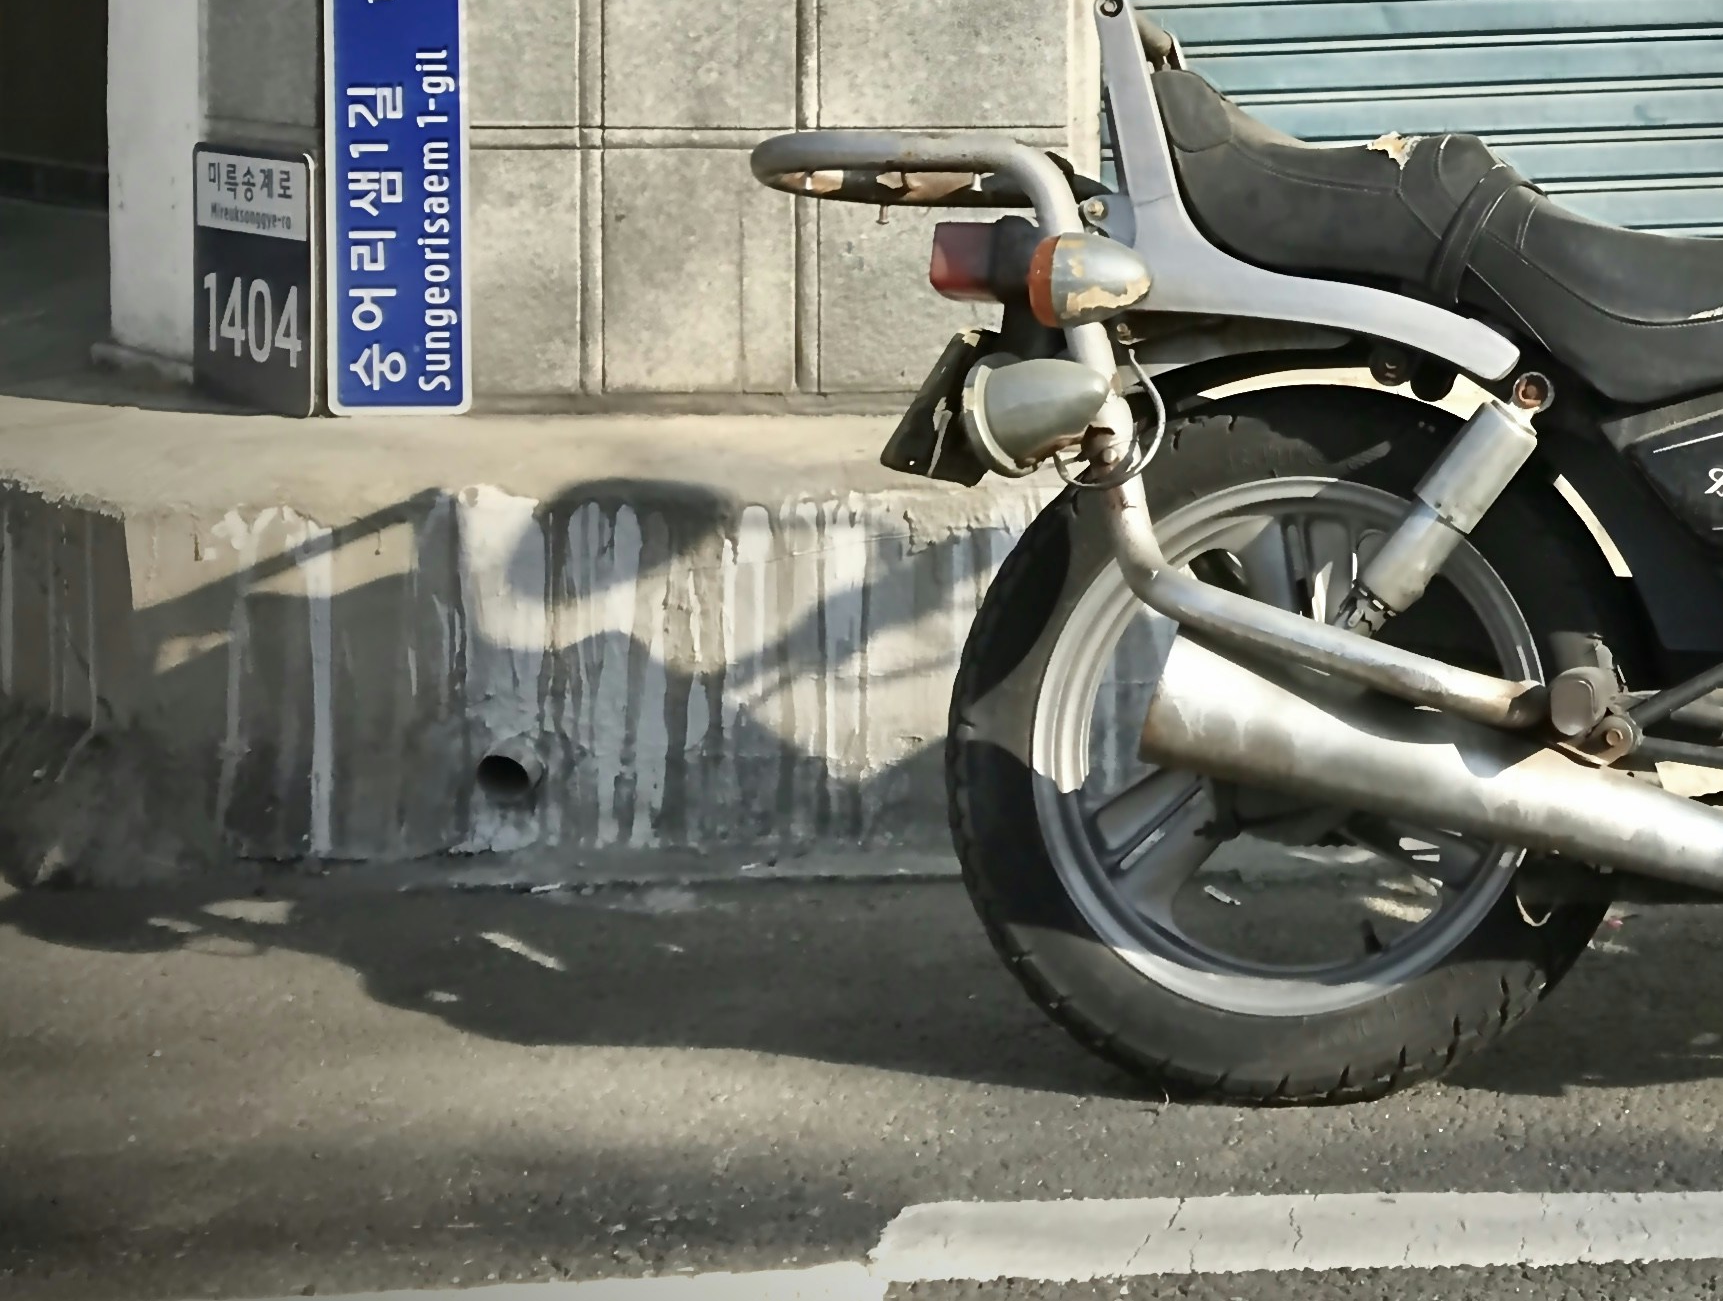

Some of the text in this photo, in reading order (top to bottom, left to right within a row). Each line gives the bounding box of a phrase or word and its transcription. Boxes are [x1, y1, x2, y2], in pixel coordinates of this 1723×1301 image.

[208, 162, 293, 203] 미륵송계로
[211, 202, 293, 230] Mireuksonggye-ro
[415, 49, 458, 392] Sungeorisaem 1-gil
[347, 86, 408, 392] 숭어리샘1길
[203, 272, 302, 368] 1404
